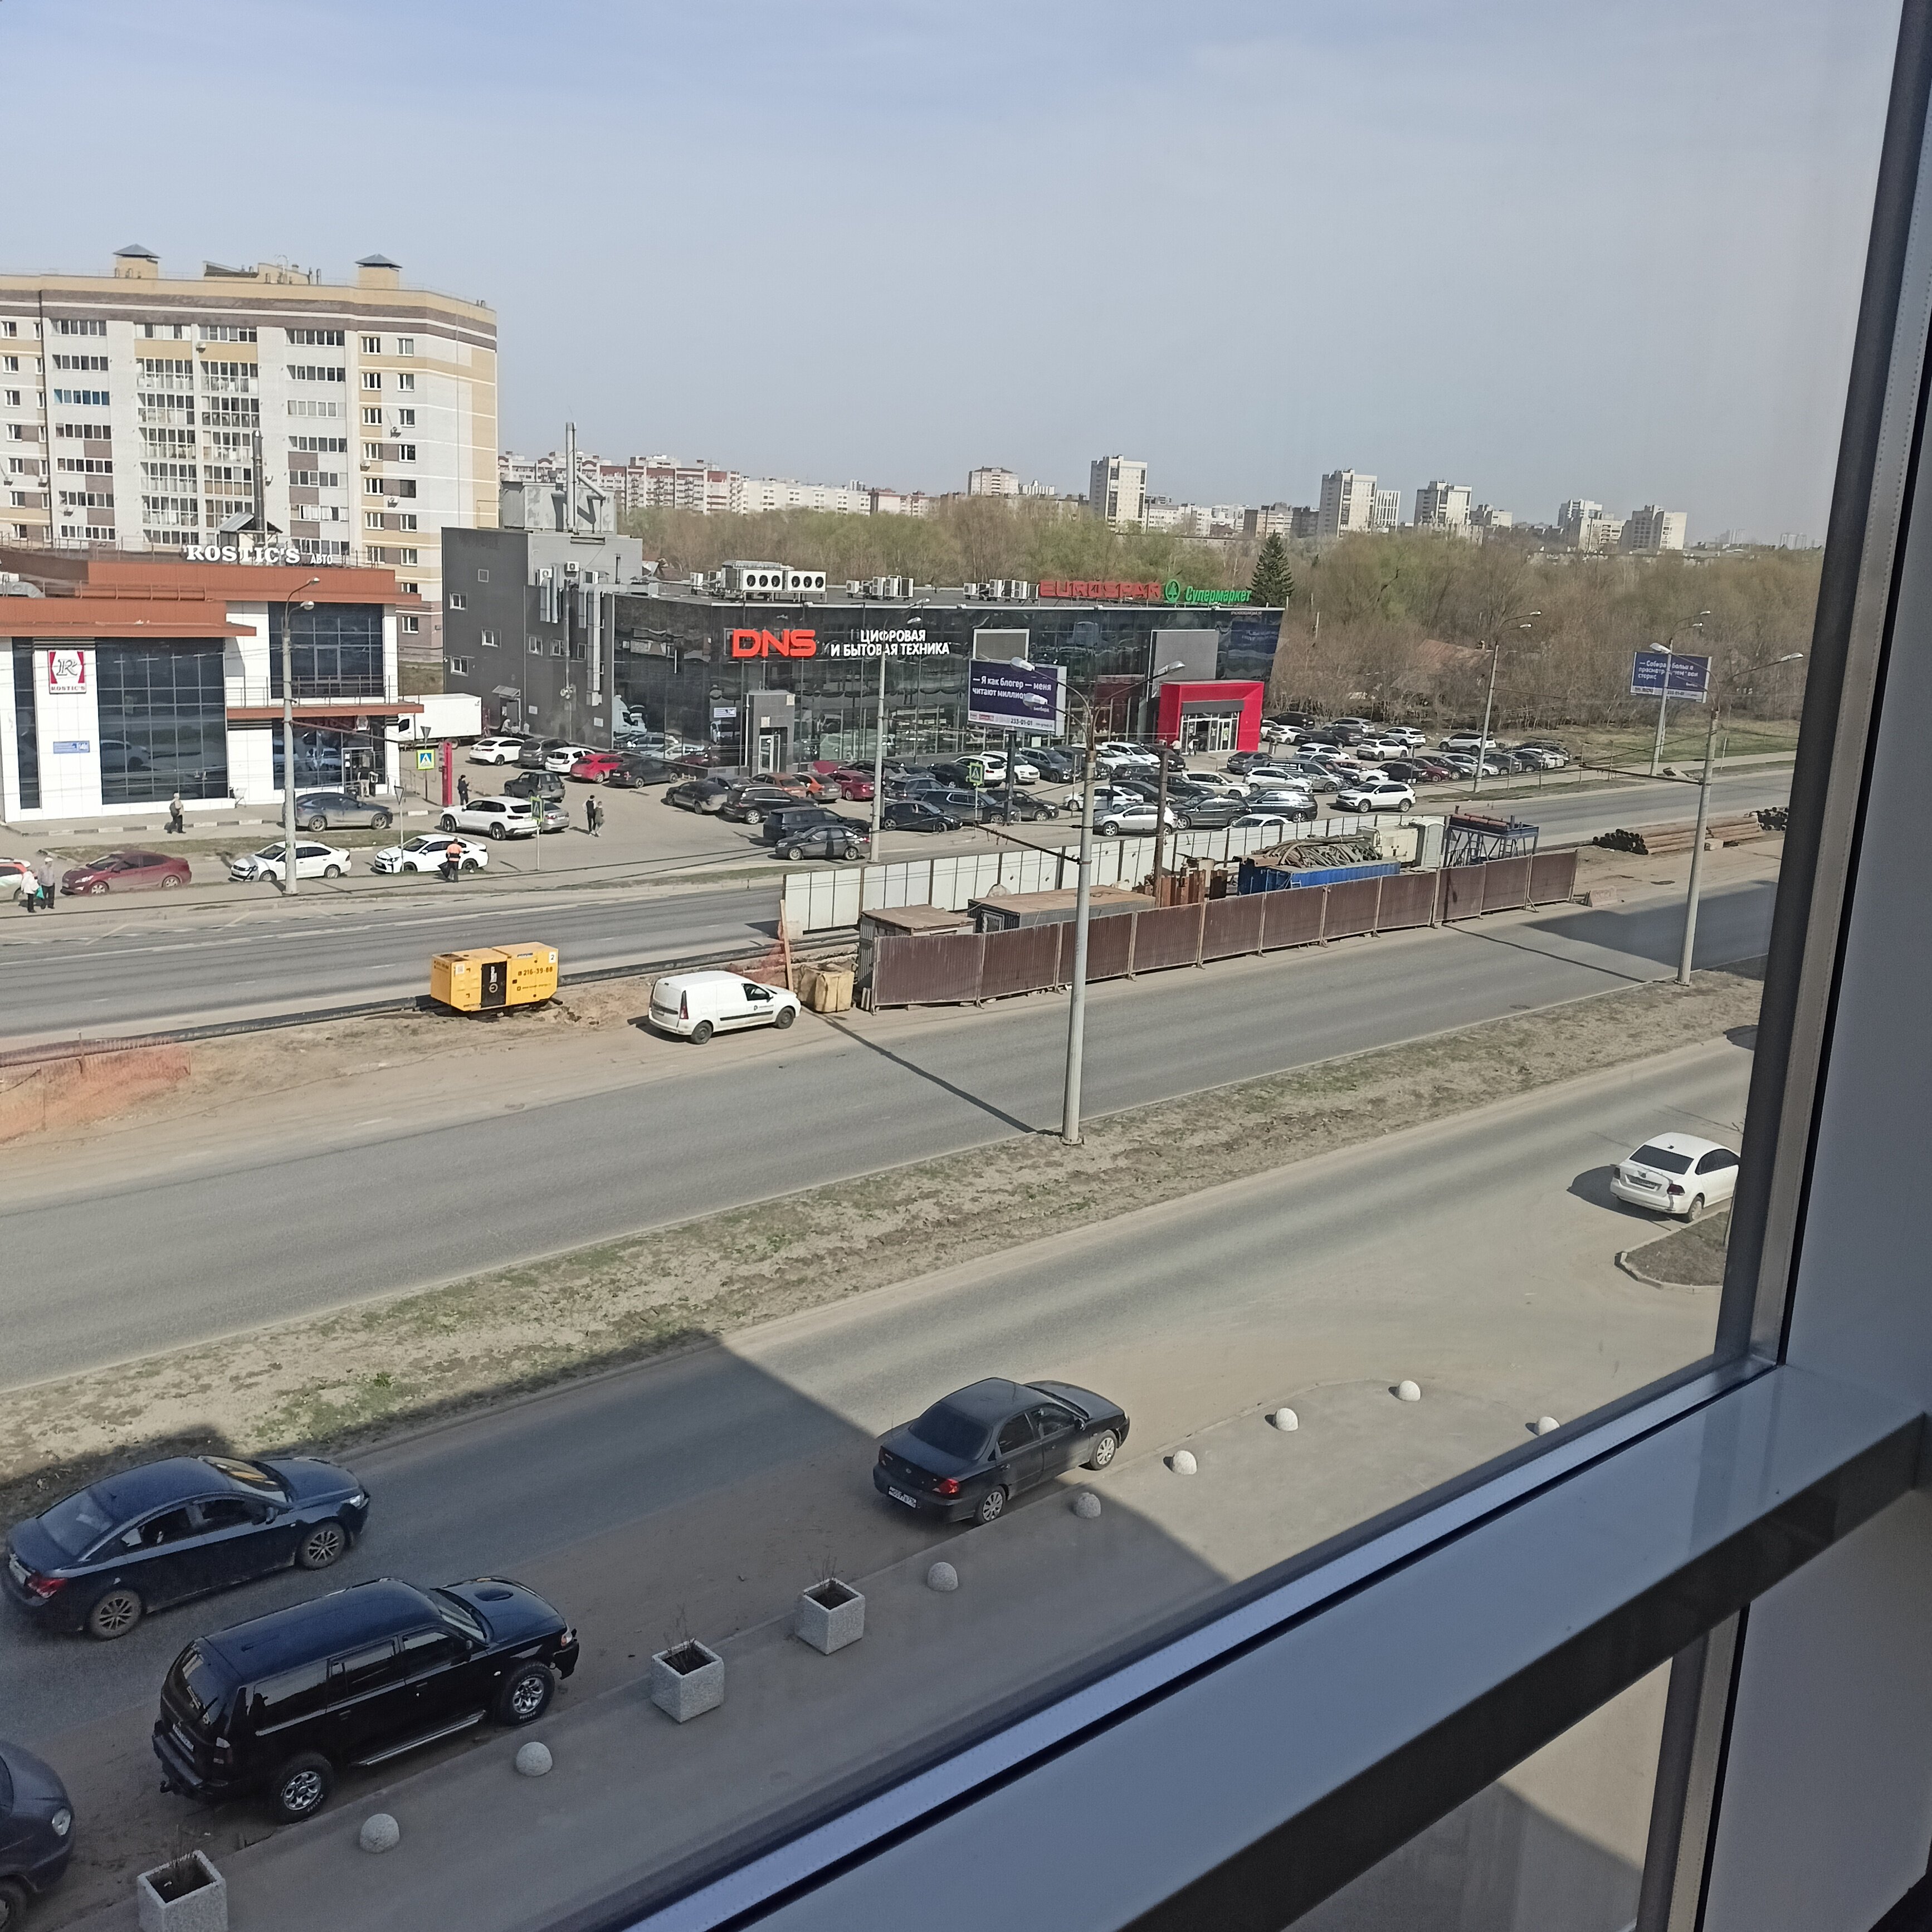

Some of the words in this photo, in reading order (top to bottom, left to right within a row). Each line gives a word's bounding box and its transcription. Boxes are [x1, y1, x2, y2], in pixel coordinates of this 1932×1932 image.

[186, 544, 301, 564] ROSTIC'S
[1040, 580, 1161, 598] EUROSPAR
[1184, 586, 1252, 604] Супермаркет
[732, 628, 816, 658] DNS
[860, 629, 926, 643] ЦИФРОВАЯ
[831, 643, 840, 657] И
[843, 643, 898, 656] БЫТОВАЯ
[900, 642, 950, 655] ТЕХНИКА
[1646, 660, 1668, 669] Собира
[981, 676, 987, 684] Я
[1000, 677, 1024, 690] блогер
[972, 687, 997, 696] читают
[997, 690, 1026, 699] миллио
